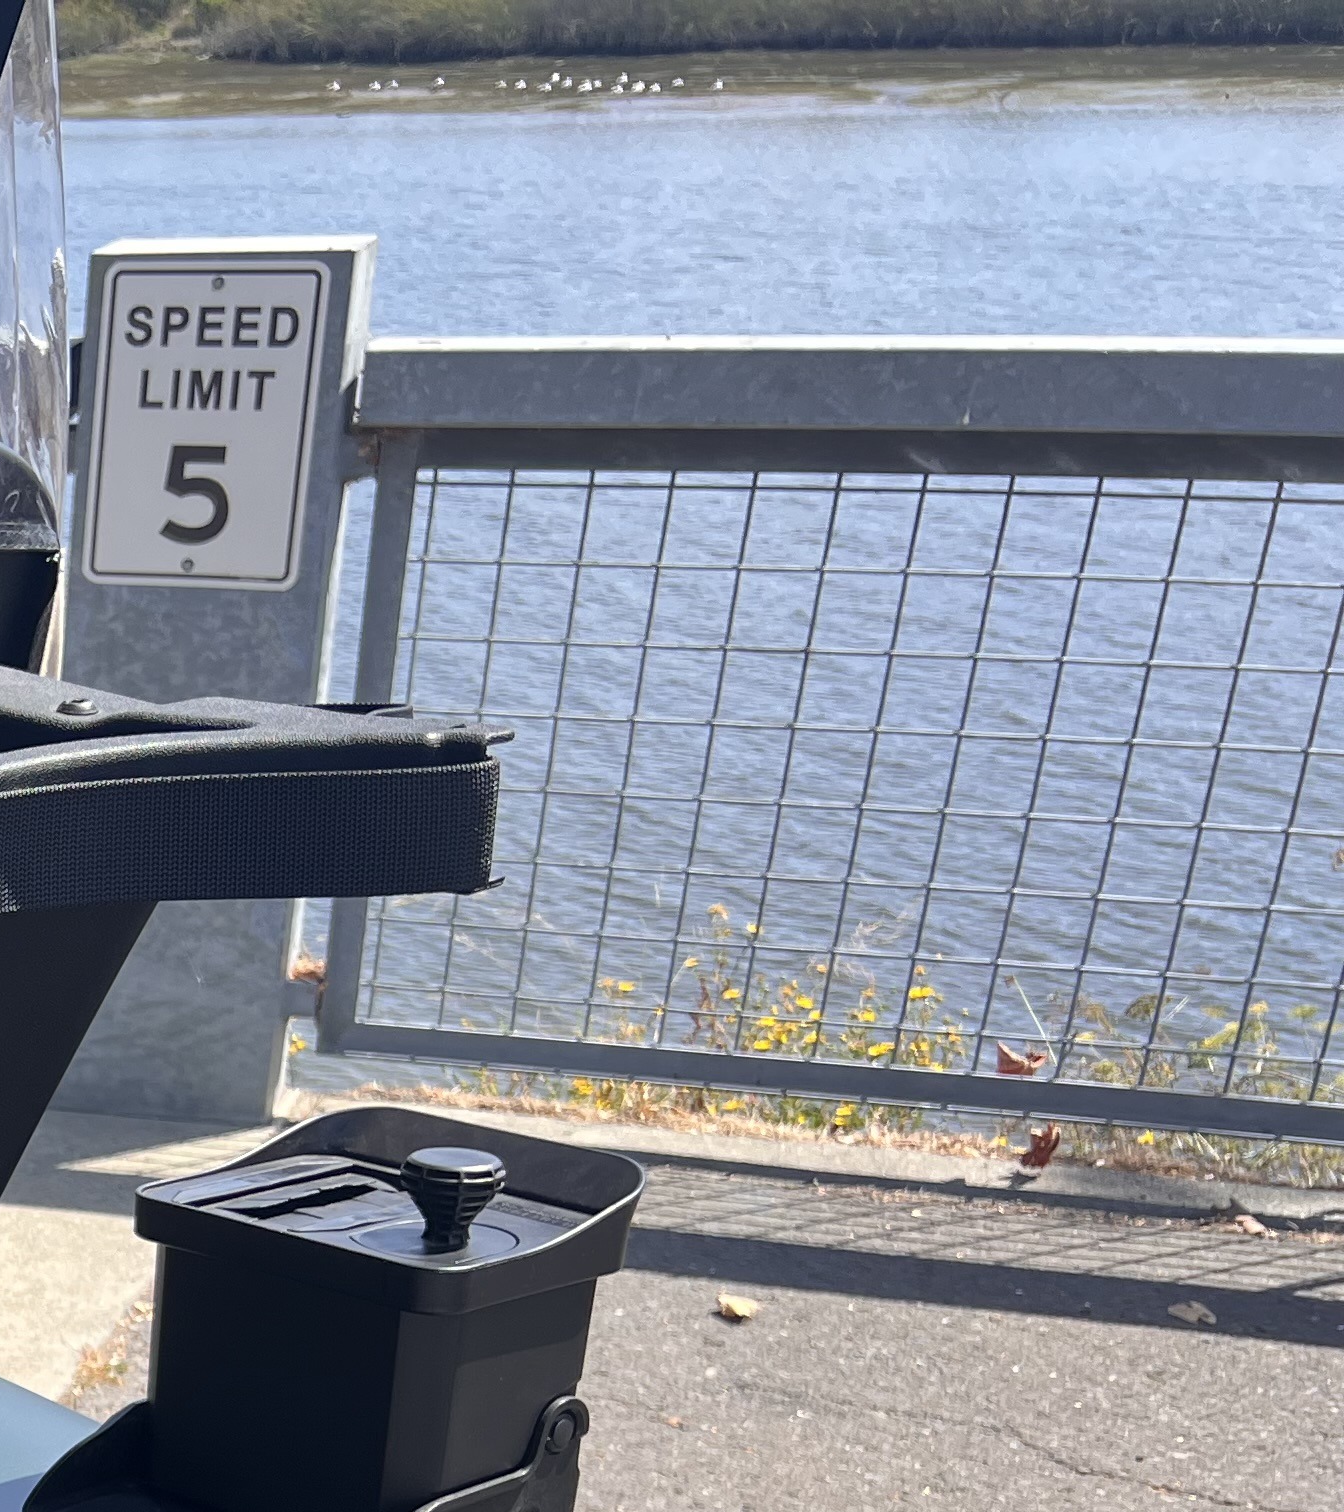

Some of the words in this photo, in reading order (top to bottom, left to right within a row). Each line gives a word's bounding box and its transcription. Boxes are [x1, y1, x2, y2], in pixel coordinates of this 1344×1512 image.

[124, 306, 300, 347] SPEED
[138, 369, 276, 410] LIMIT
[159, 445, 229, 545] 5
